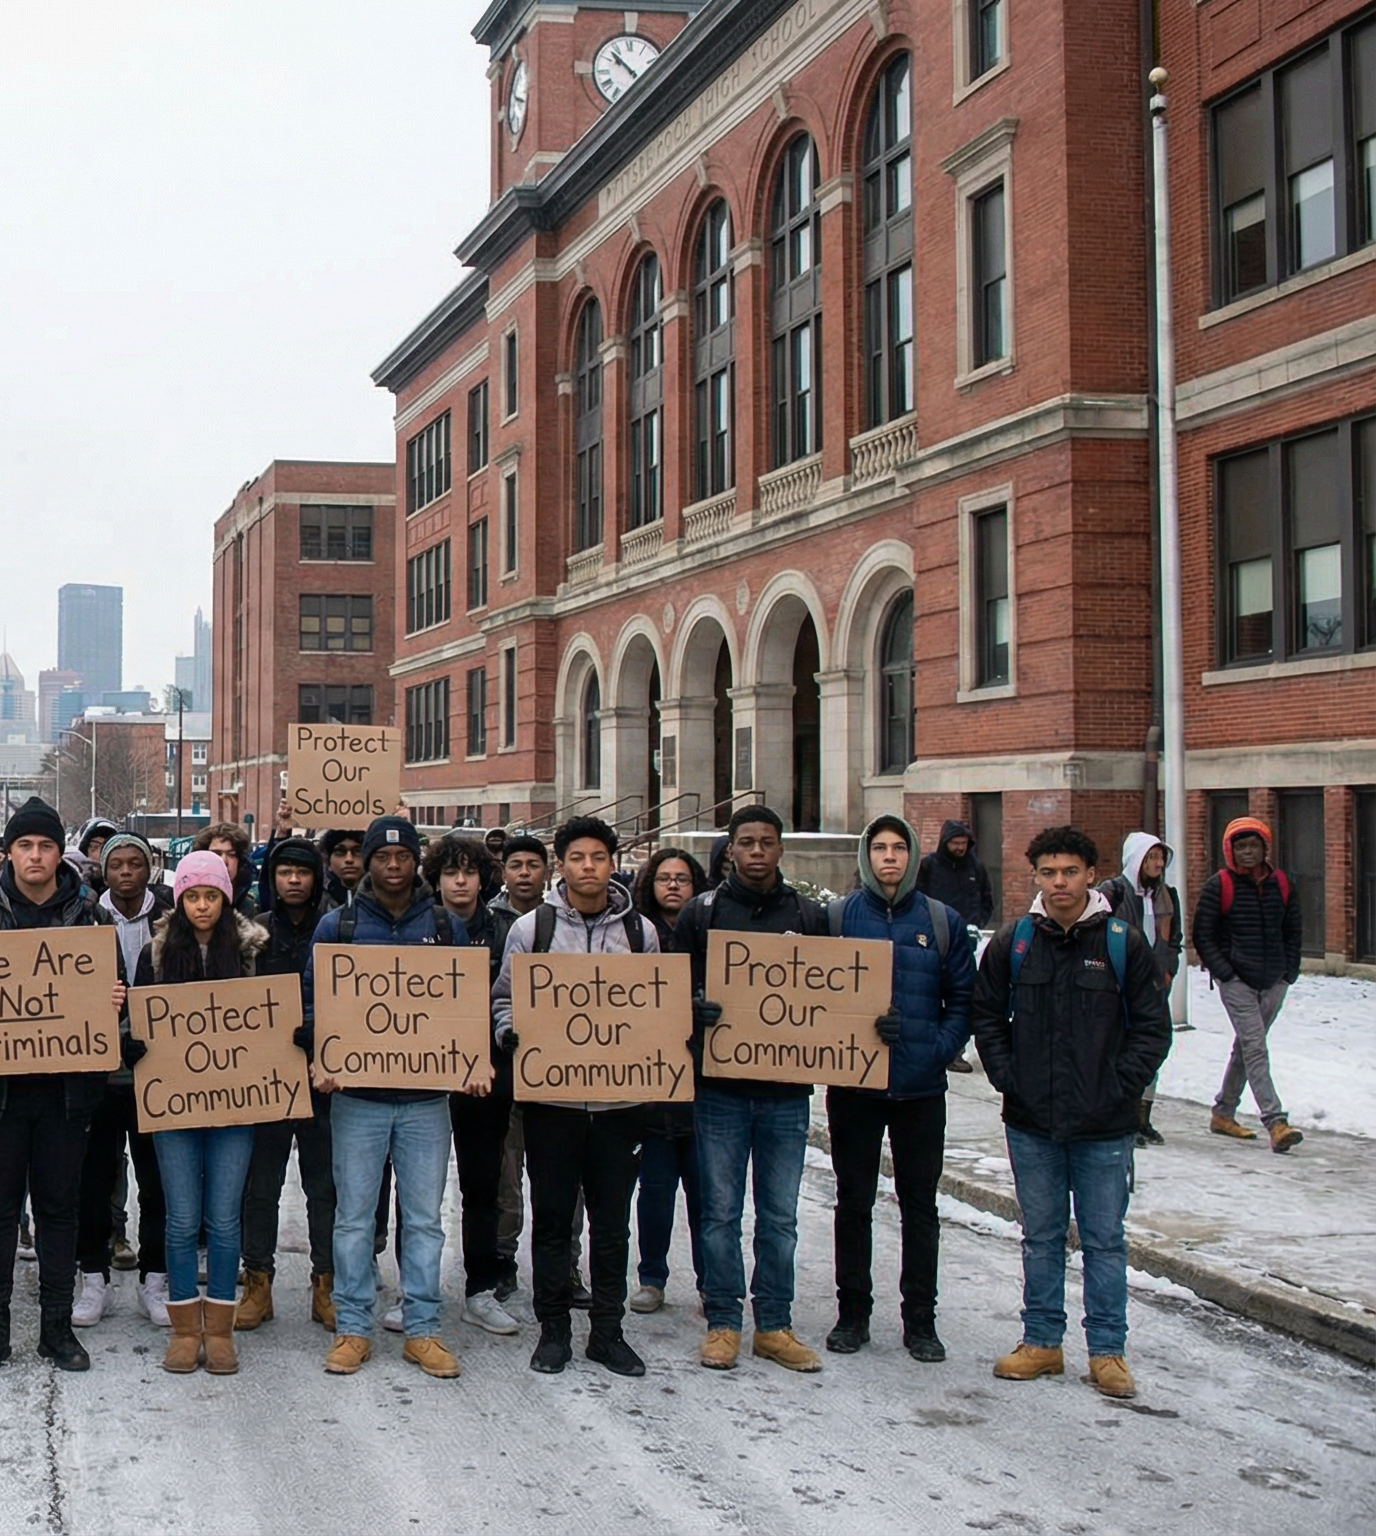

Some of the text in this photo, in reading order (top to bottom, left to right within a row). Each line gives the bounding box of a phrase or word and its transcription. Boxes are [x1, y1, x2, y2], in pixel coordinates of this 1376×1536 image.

[751, 1, 816, 70] SCHOOL
[298, 727, 389, 753] Protect
[323, 759, 370, 782] Our
[294, 788, 385, 815] Schools
[33, 941, 94, 976] Are
[332, 954, 465, 998] Protect
[725, 941, 868, 992] Protect
[0, 982, 58, 1016] Not
[530, 964, 668, 1008] Protect
[146, 989, 279, 1039] Protect
[366, 1003, 429, 1035] Our
[566, 1013, 631, 1046] Our
[759, 994, 827, 1026] Our
[185, 1041, 248, 1073] Our
[319, 1035, 479, 1086] Community
[521, 1047, 685, 1098] Community
[708, 1022, 880, 1085] Community
[143, 1068, 300, 1118] Community
